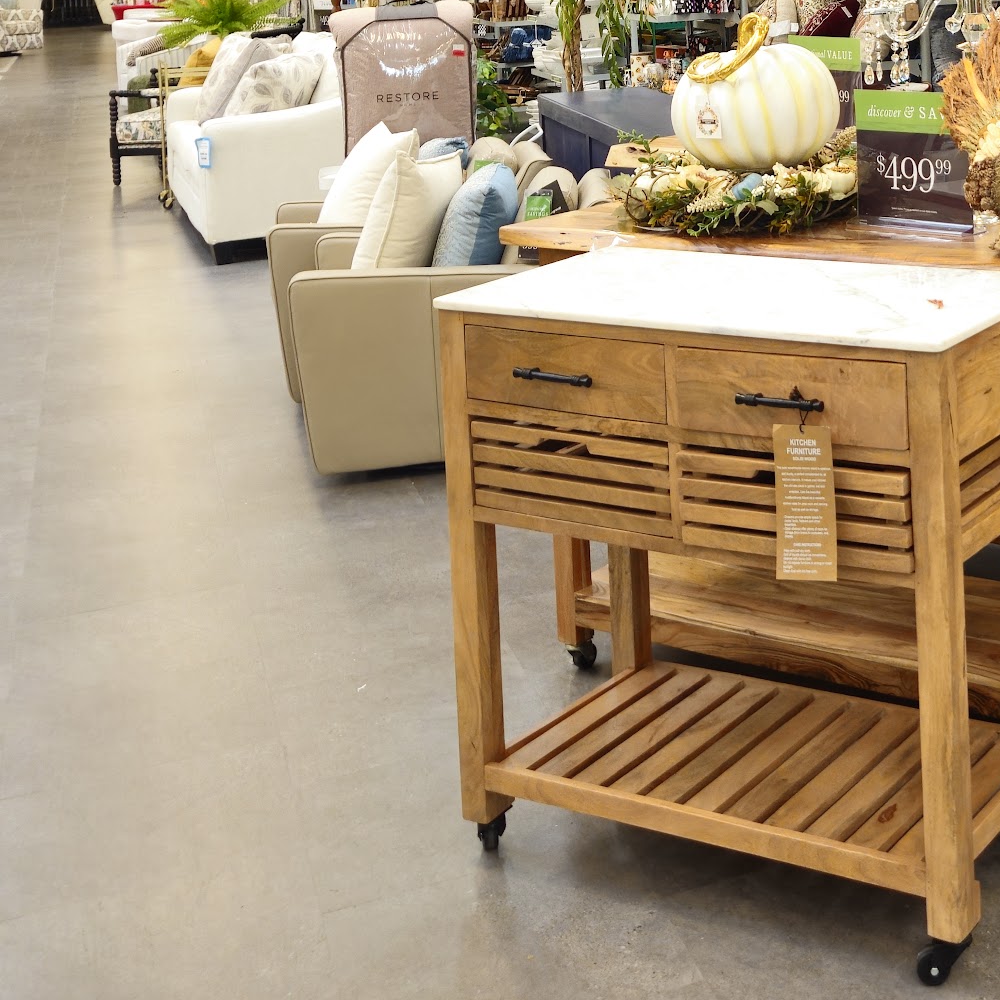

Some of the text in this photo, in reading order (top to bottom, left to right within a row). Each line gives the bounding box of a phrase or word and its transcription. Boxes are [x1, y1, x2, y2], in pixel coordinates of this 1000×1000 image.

[827, 50, 853, 60] VALUE
[376, 91, 439, 103] RESTORE
[867, 105, 902, 118] discover
[903, 106, 915, 119] &
[790, 439, 817, 447] KITCHEN
